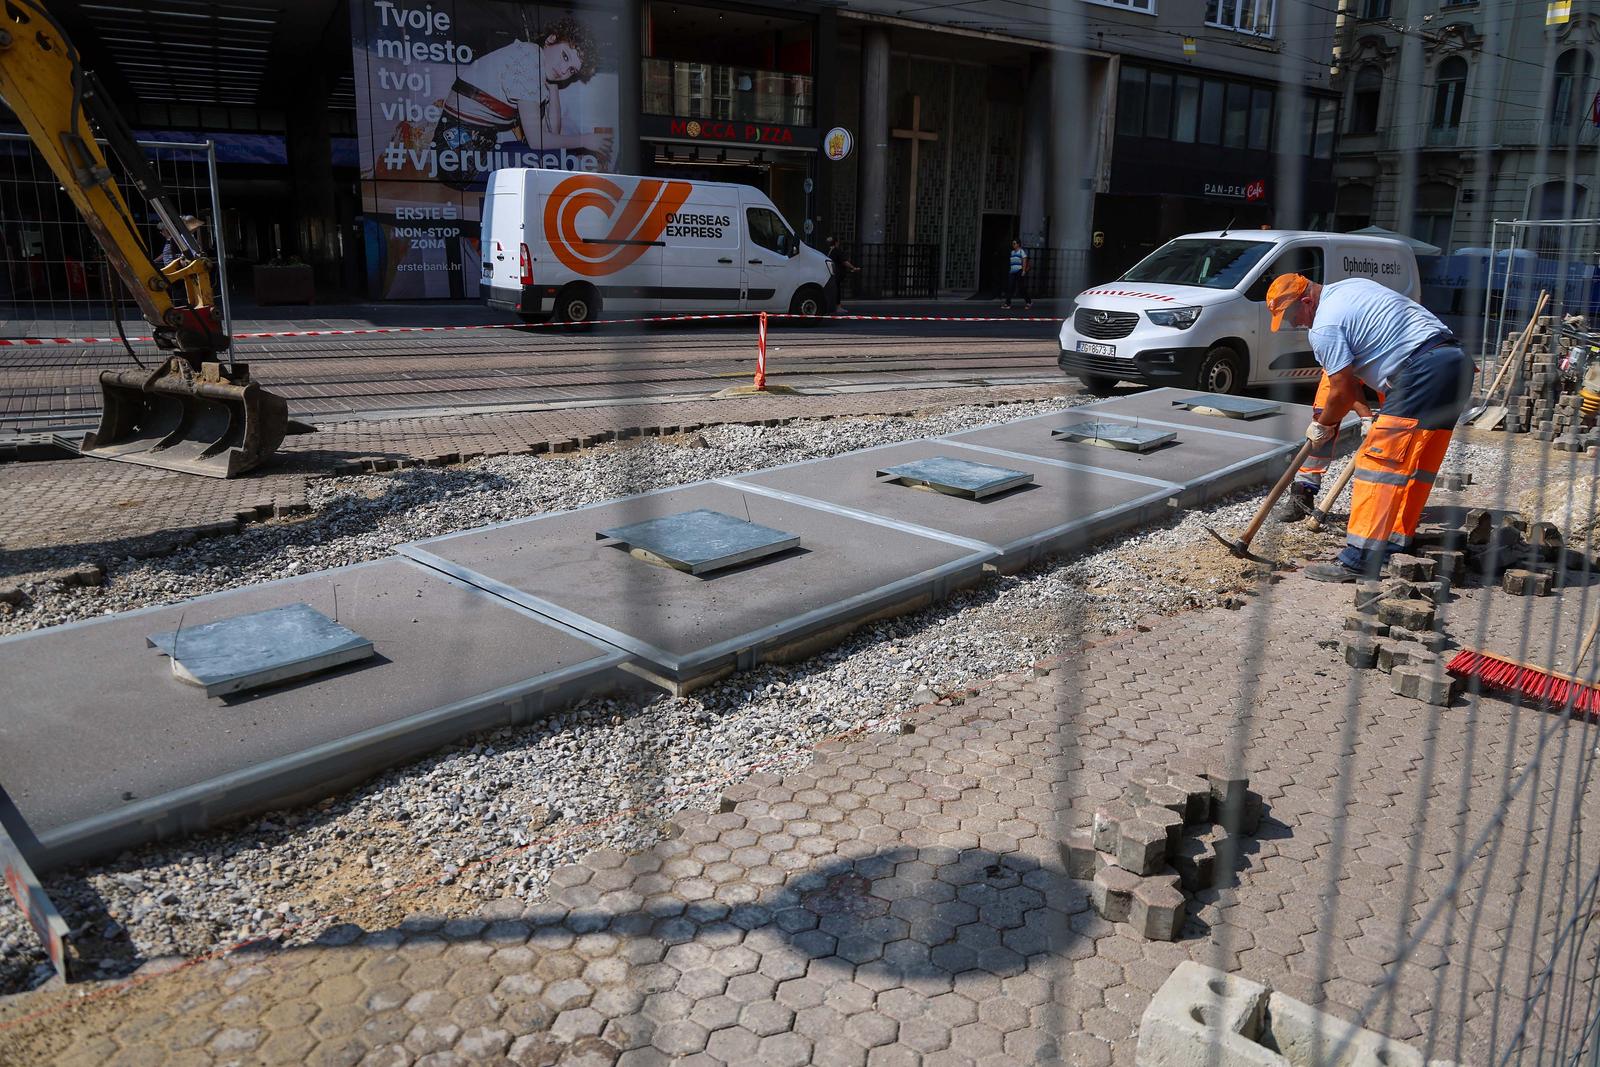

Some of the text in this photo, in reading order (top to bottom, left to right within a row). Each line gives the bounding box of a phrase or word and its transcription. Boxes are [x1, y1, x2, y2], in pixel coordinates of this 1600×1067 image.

[374, 1, 450, 35] Tvoje
[377, 35, 474, 66] mjesto
[378, 66, 431, 98] tvoj
[381, 99, 448, 123] vibe.
[745, 126, 793, 144] PIZZA
[1204, 183, 1246, 197] PAN-PEK
[665, 212, 731, 227] OVERSEAS
[395, 227, 460, 238] NON-STOP
[666, 226, 723, 239] EXPRESS
[411, 238, 446, 249] ZONA
[396, 261, 462, 272] erstebank.hr
[1343, 256, 1402, 278] Ophodnja ceste
